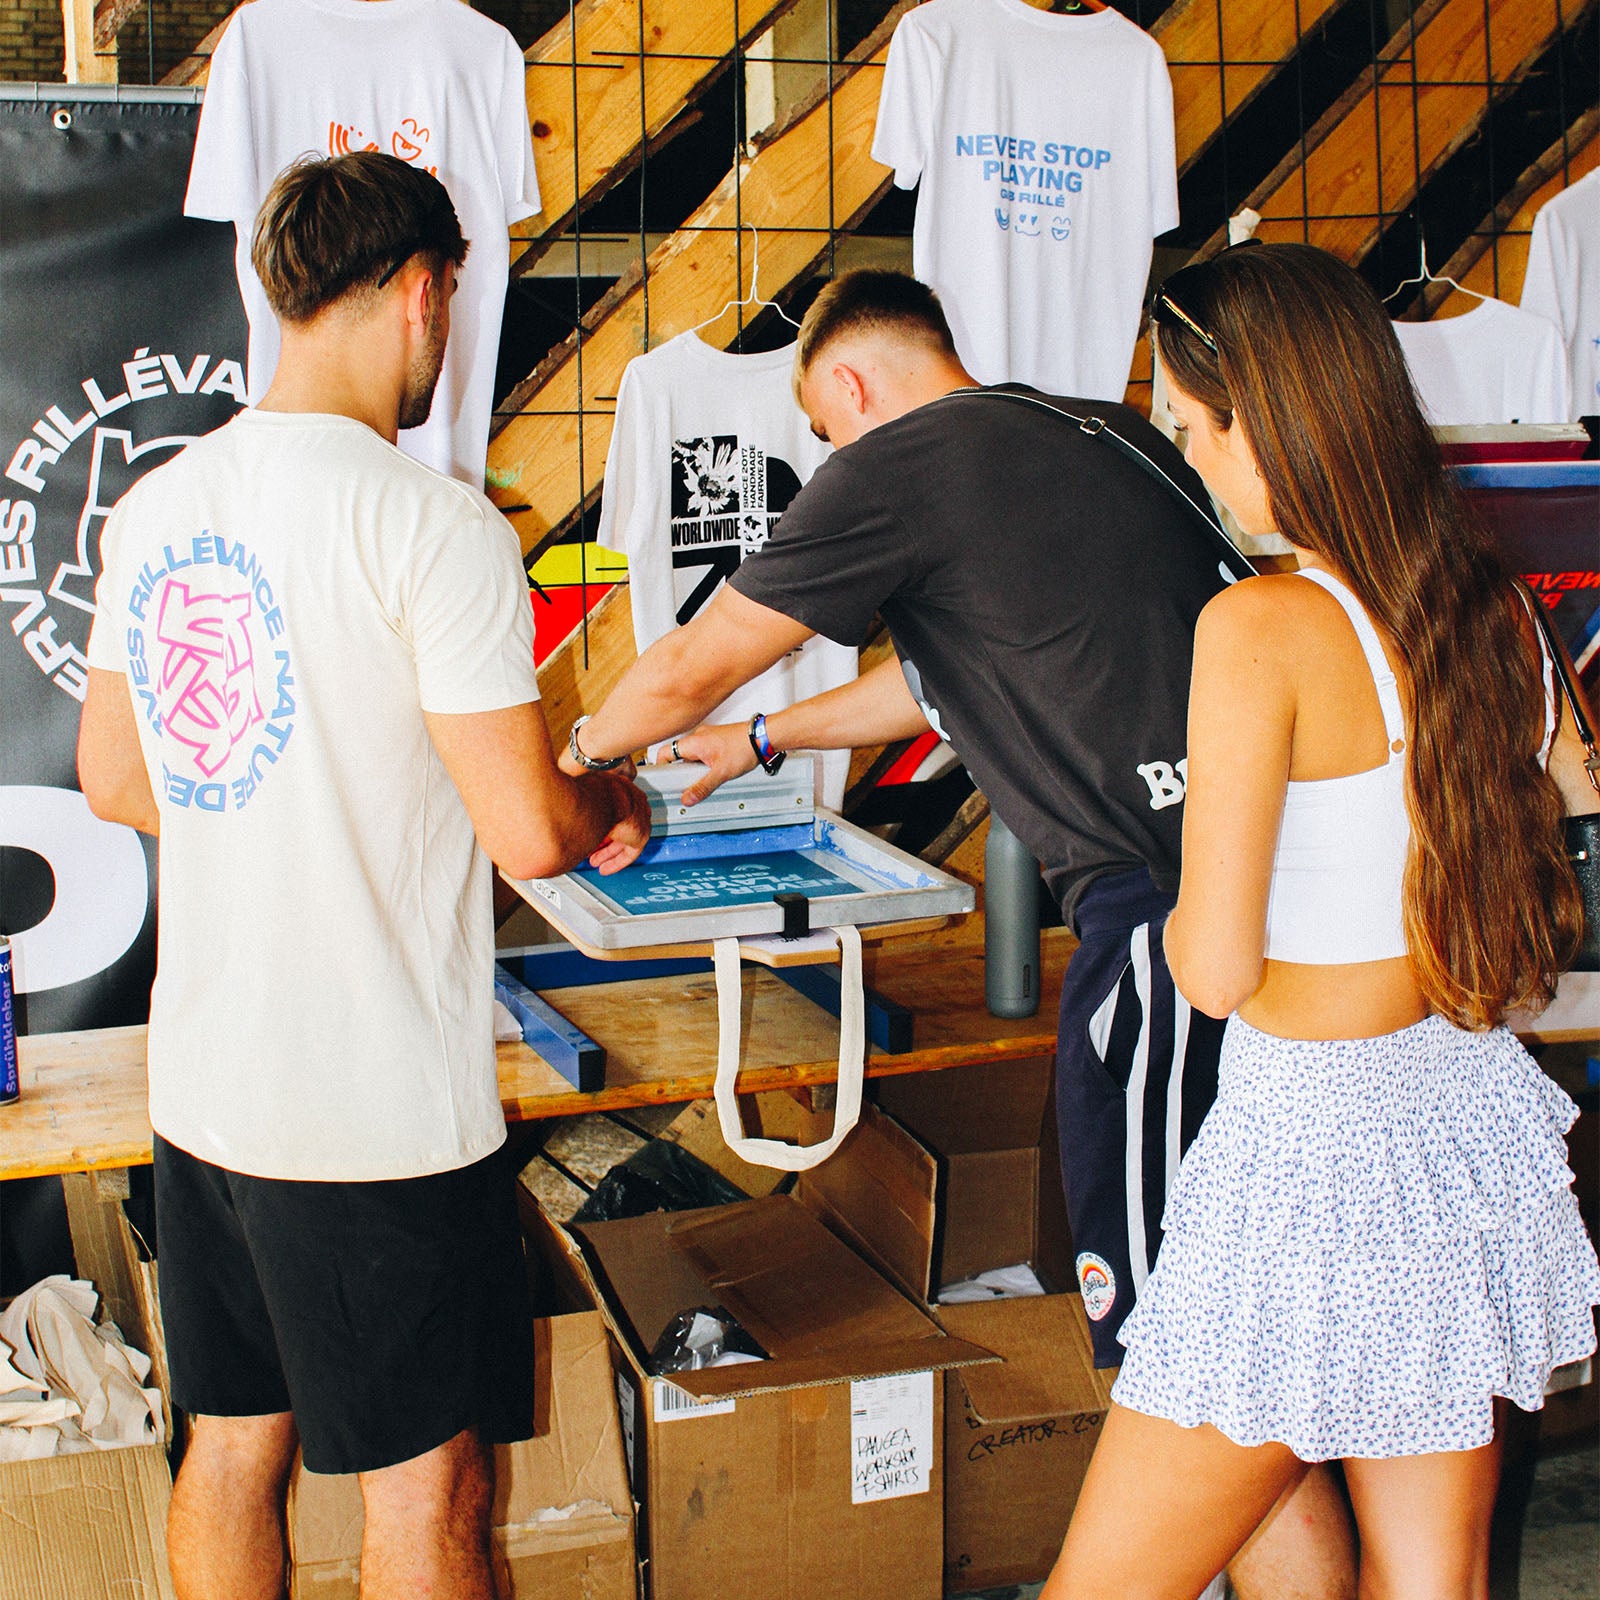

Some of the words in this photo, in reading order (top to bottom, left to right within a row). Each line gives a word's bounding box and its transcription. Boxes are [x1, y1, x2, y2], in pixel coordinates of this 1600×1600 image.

[956, 134, 1036, 161] NEVER
[1043, 142, 1111, 170] STOP
[983, 160, 1082, 193] PLAYING
[741, 447, 749, 474] 2017
[749, 444, 757, 508] HANDMADE
[671, 517, 740, 547] WORLDWIDE
[625, 889, 719, 904] STOP
[648, 874, 803, 894] PLAYING
[2, 981, 17, 1093] Sprühkleber
